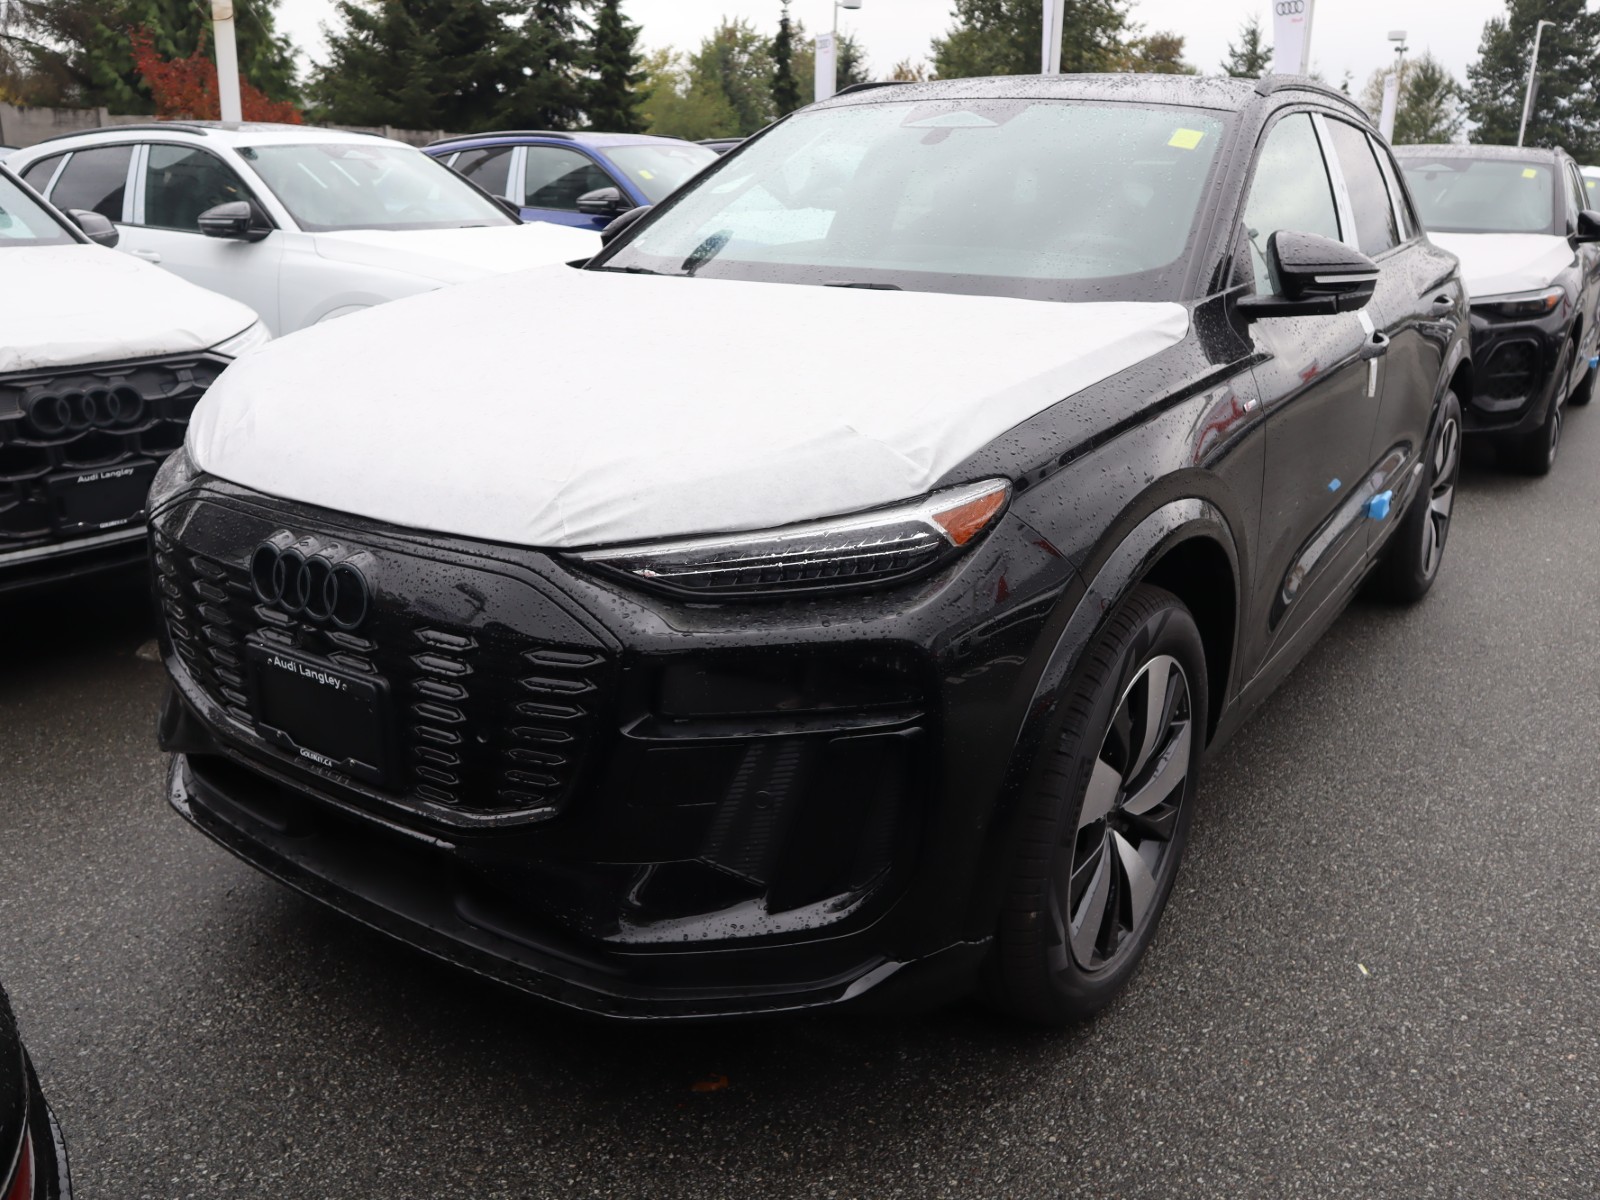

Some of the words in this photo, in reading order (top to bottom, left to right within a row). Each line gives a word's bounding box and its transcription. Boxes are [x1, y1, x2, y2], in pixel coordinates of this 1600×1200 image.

[77, 473, 99, 483] Audi
[100, 467, 134, 479] Langley
[273, 656, 297, 672] Audi
[299, 664, 341, 689] Langley
